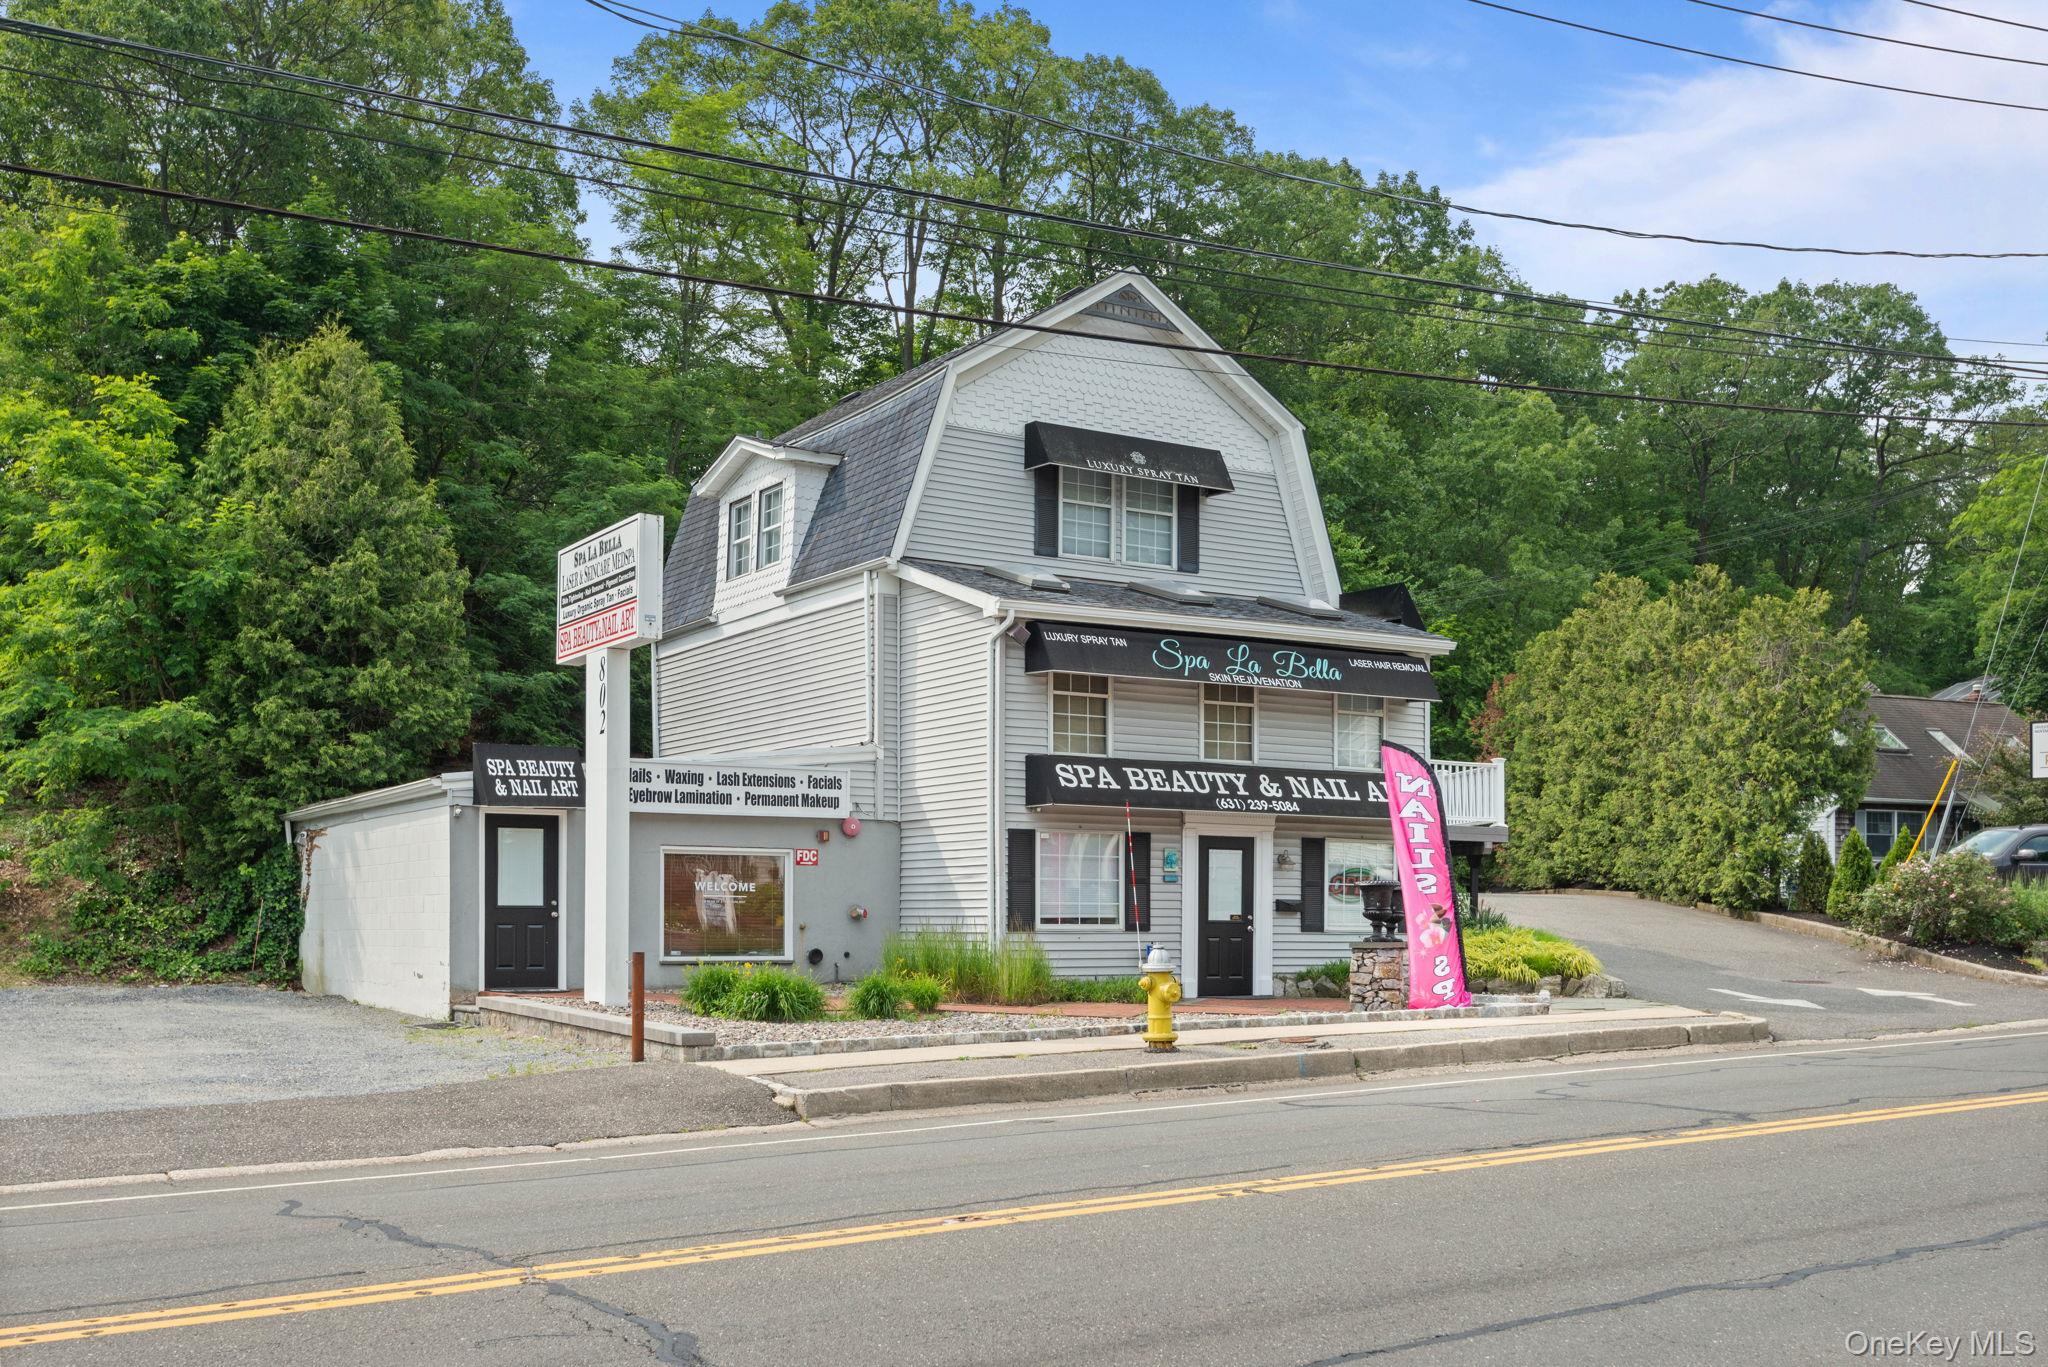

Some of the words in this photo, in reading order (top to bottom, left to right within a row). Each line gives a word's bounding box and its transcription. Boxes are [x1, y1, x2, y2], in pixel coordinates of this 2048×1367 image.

[1086, 459, 1133, 474] LUXURY
[1137, 467, 1173, 480] SPRAY
[1175, 473, 1199, 484] TAN
[574, 550, 587, 568] SPA
[588, 545, 598, 562] LA
[599, 533, 622, 558] BELLA
[562, 572, 579, 592] LASER
[563, 608, 577, 619] Luxury
[577, 601, 593, 615] Organic
[593, 597, 606, 609] Spray
[606, 592, 615, 603] Tan
[617, 584, 634, 599] Facials
[560, 630, 572, 653] SPA
[620, 607, 636, 632] ART
[1043, 631, 1078, 643] LUXURY
[1081, 635, 1108, 646] SPRAY
[1110, 637, 1128, 647] TAN
[1152, 638, 1210, 677] Spa
[1225, 643, 1262, 677] La
[1272, 650, 1342, 681] Bella
[1348, 658, 1374, 669] LASER
[1373, 660, 1393, 670] HAIR
[1392, 662, 1428, 673] REMOVAL
[1208, 672, 1232, 684] SKIN
[1232, 674, 1303, 689] REJUVENATION
[486, 758, 516, 777] SPA
[516, 759, 576, 778] BEAUTY
[495, 778, 508, 797] &
[508, 779, 547, 797] NAIL
[550, 780, 579, 798] ART
[664, 769, 704, 787] Waxing
[716, 771, 740, 787] Lash
[742, 772, 796, 789] Extensions
[807, 774, 843, 791] Facials
[1055, 763, 1121, 790] SPA
[1122, 766, 1249, 796] BEAUTY
[1259, 774, 1283, 798] &
[1284, 775, 1361, 801] NAIL
[629, 787, 673, 803] Eyebrow
[674, 788, 733, 806] Lamination
[744, 791, 800, 808] Permanent
[801, 793, 840, 810] Makeup
[1215, 798, 1246, 812] (631)
[1249, 799, 1300, 813] 239-5084
[796, 849, 818, 862] FDC
[694, 881, 756, 892] WELCOME
